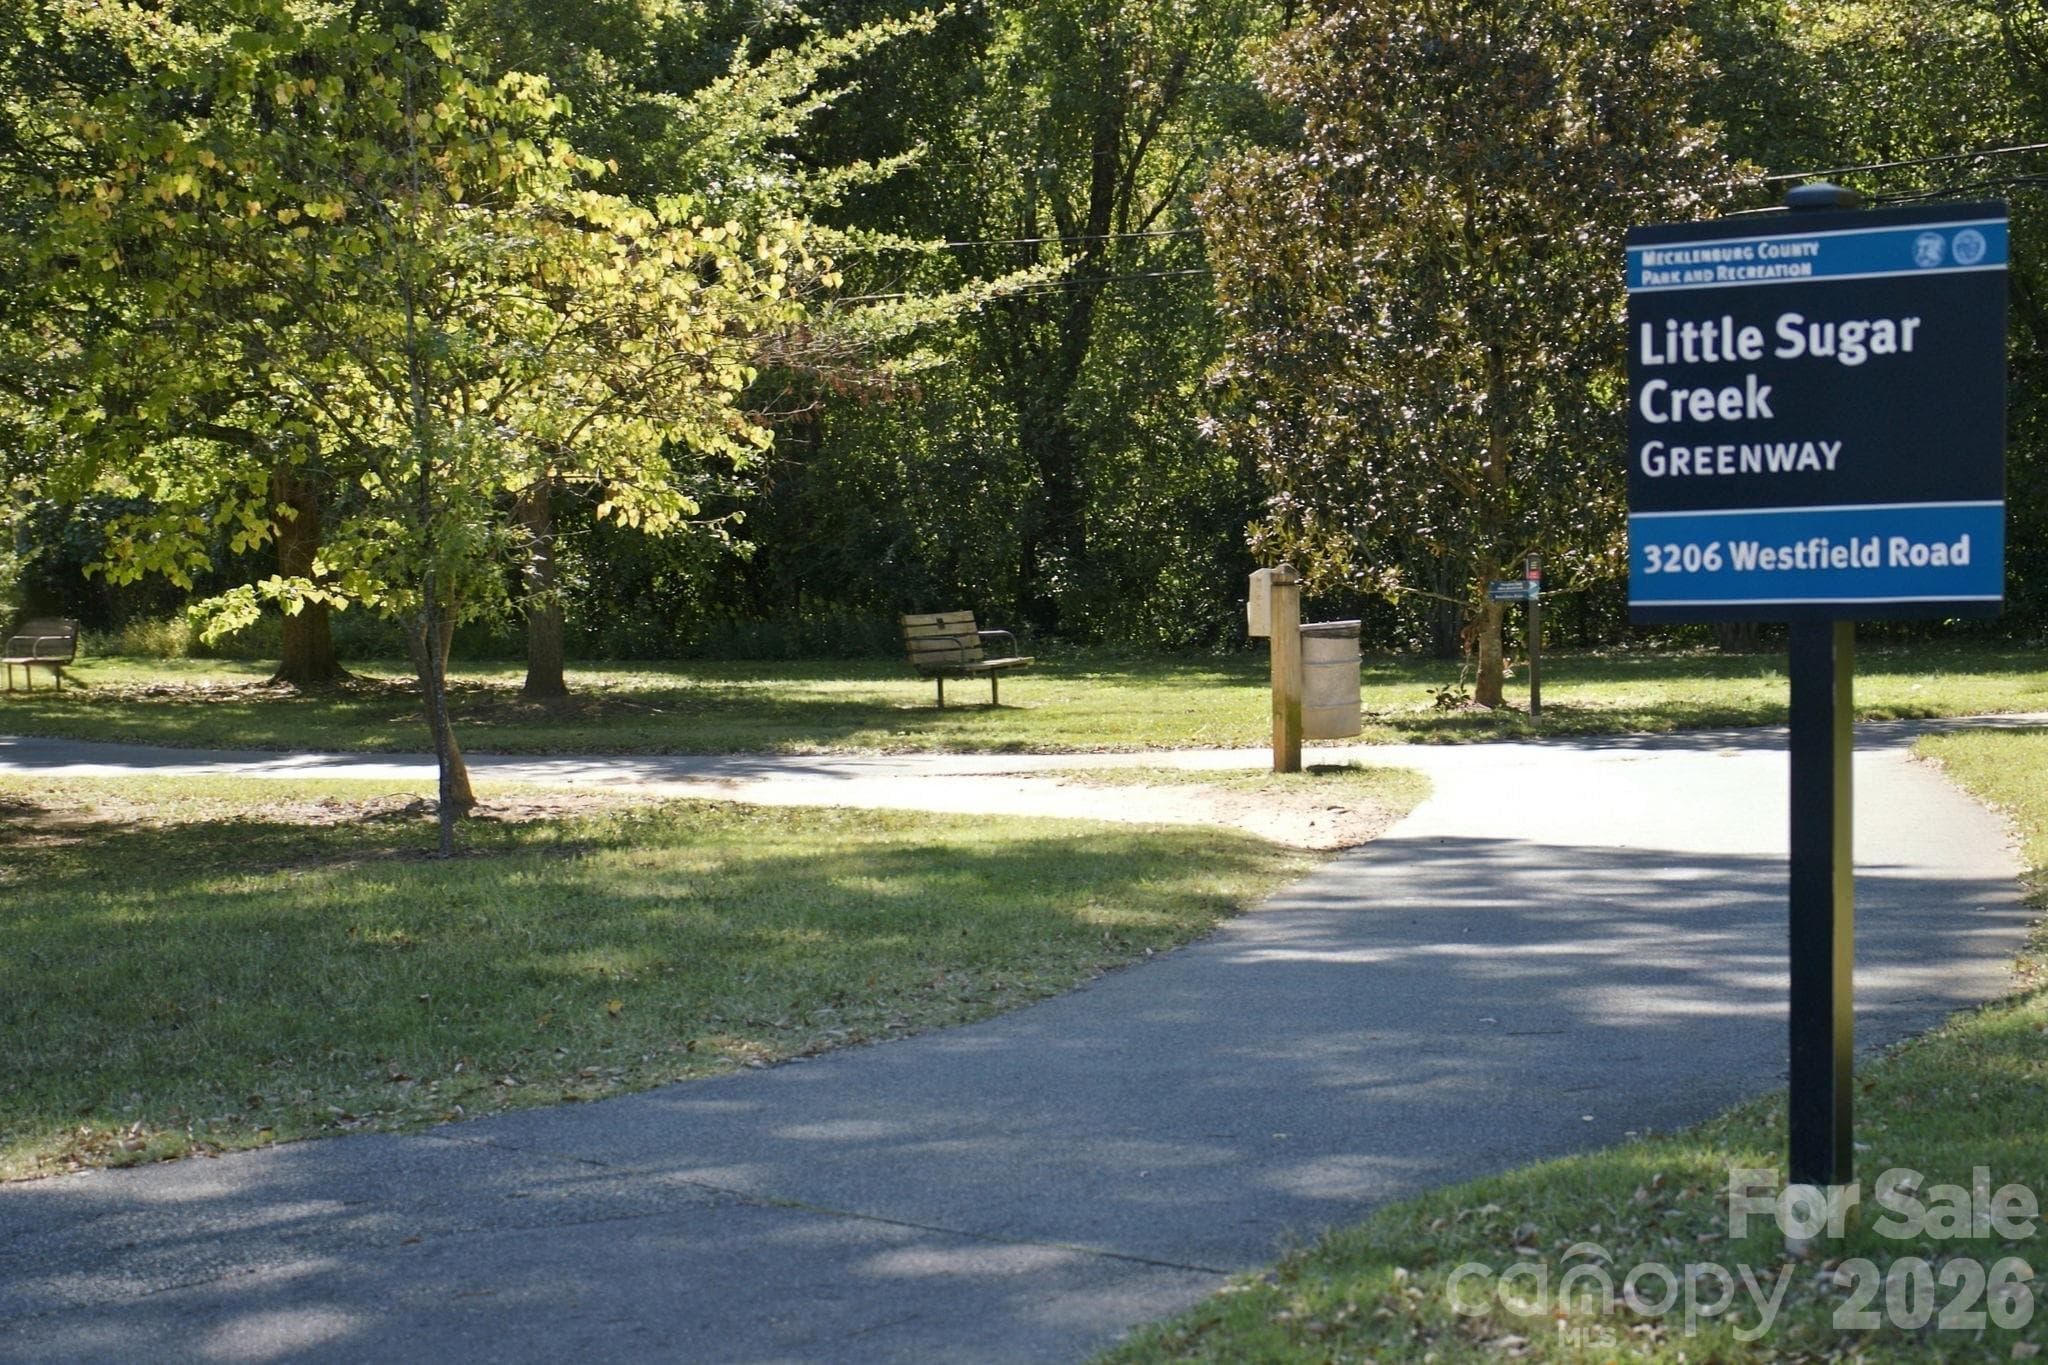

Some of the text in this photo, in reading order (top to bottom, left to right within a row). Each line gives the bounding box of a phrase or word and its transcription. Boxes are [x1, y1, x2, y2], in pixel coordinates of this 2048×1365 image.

[1642, 241, 1820, 266] MECKLENBURG COUNTY
[1641, 262, 1812, 286] PARK AND RECREATION
[1640, 312, 1921, 367] Little Sugar
[1639, 373, 1774, 424] Creek
[1640, 440, 1843, 478] GREENWAY
[1643, 533, 1971, 574] 3206 Westfield Road
